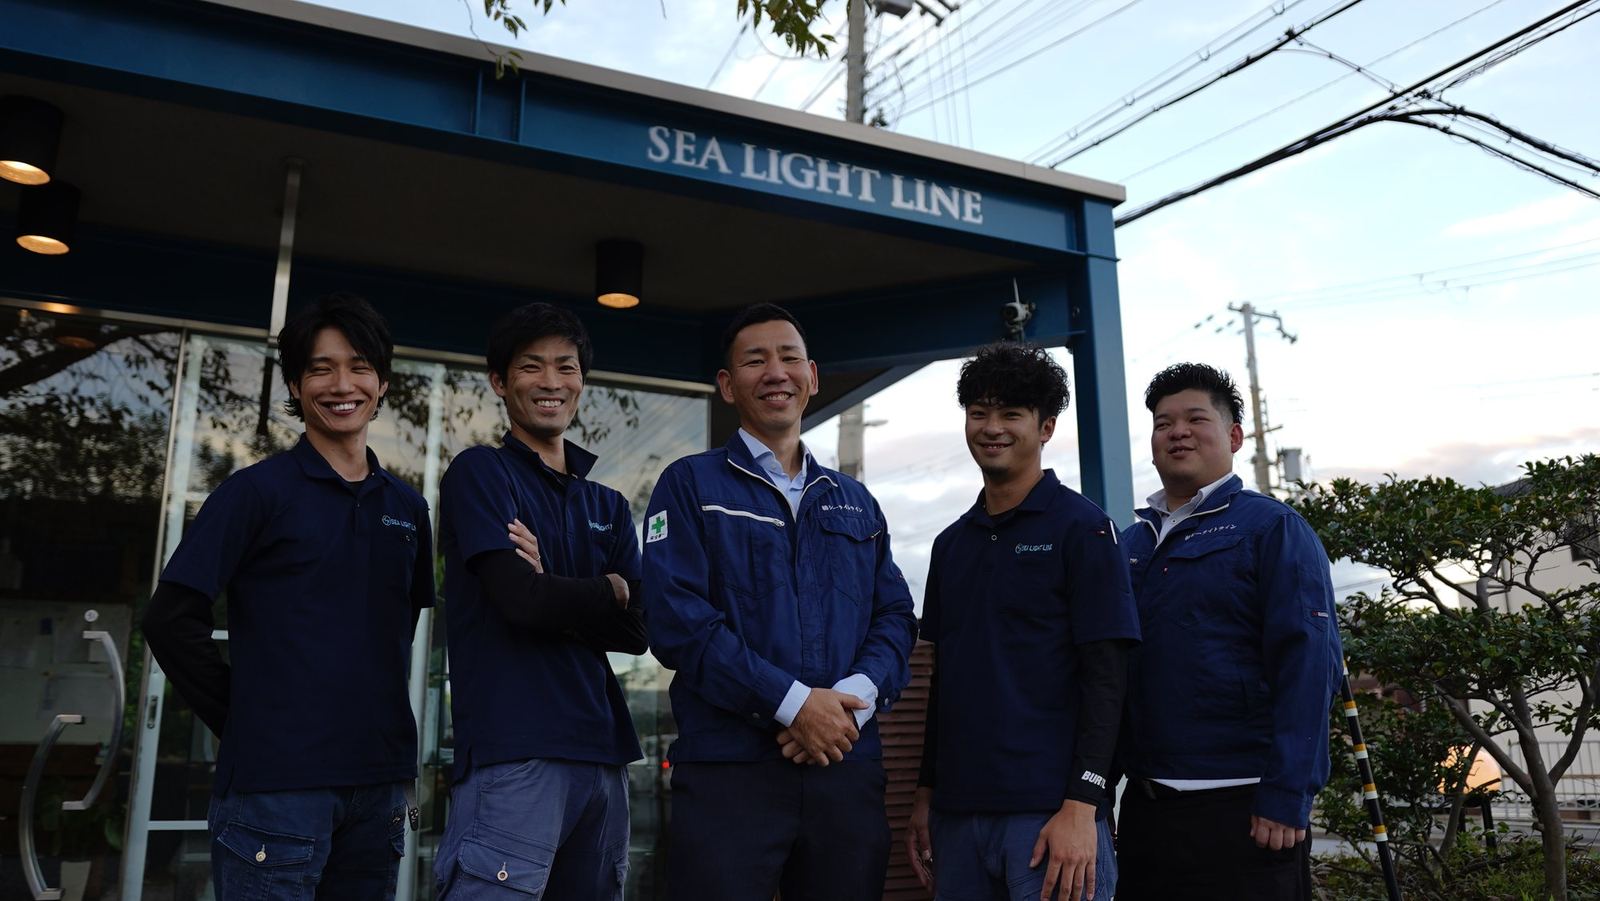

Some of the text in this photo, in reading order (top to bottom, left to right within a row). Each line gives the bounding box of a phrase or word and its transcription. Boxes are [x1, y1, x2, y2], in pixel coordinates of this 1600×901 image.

[647, 126, 984, 225] SEA LIGHT LINE
